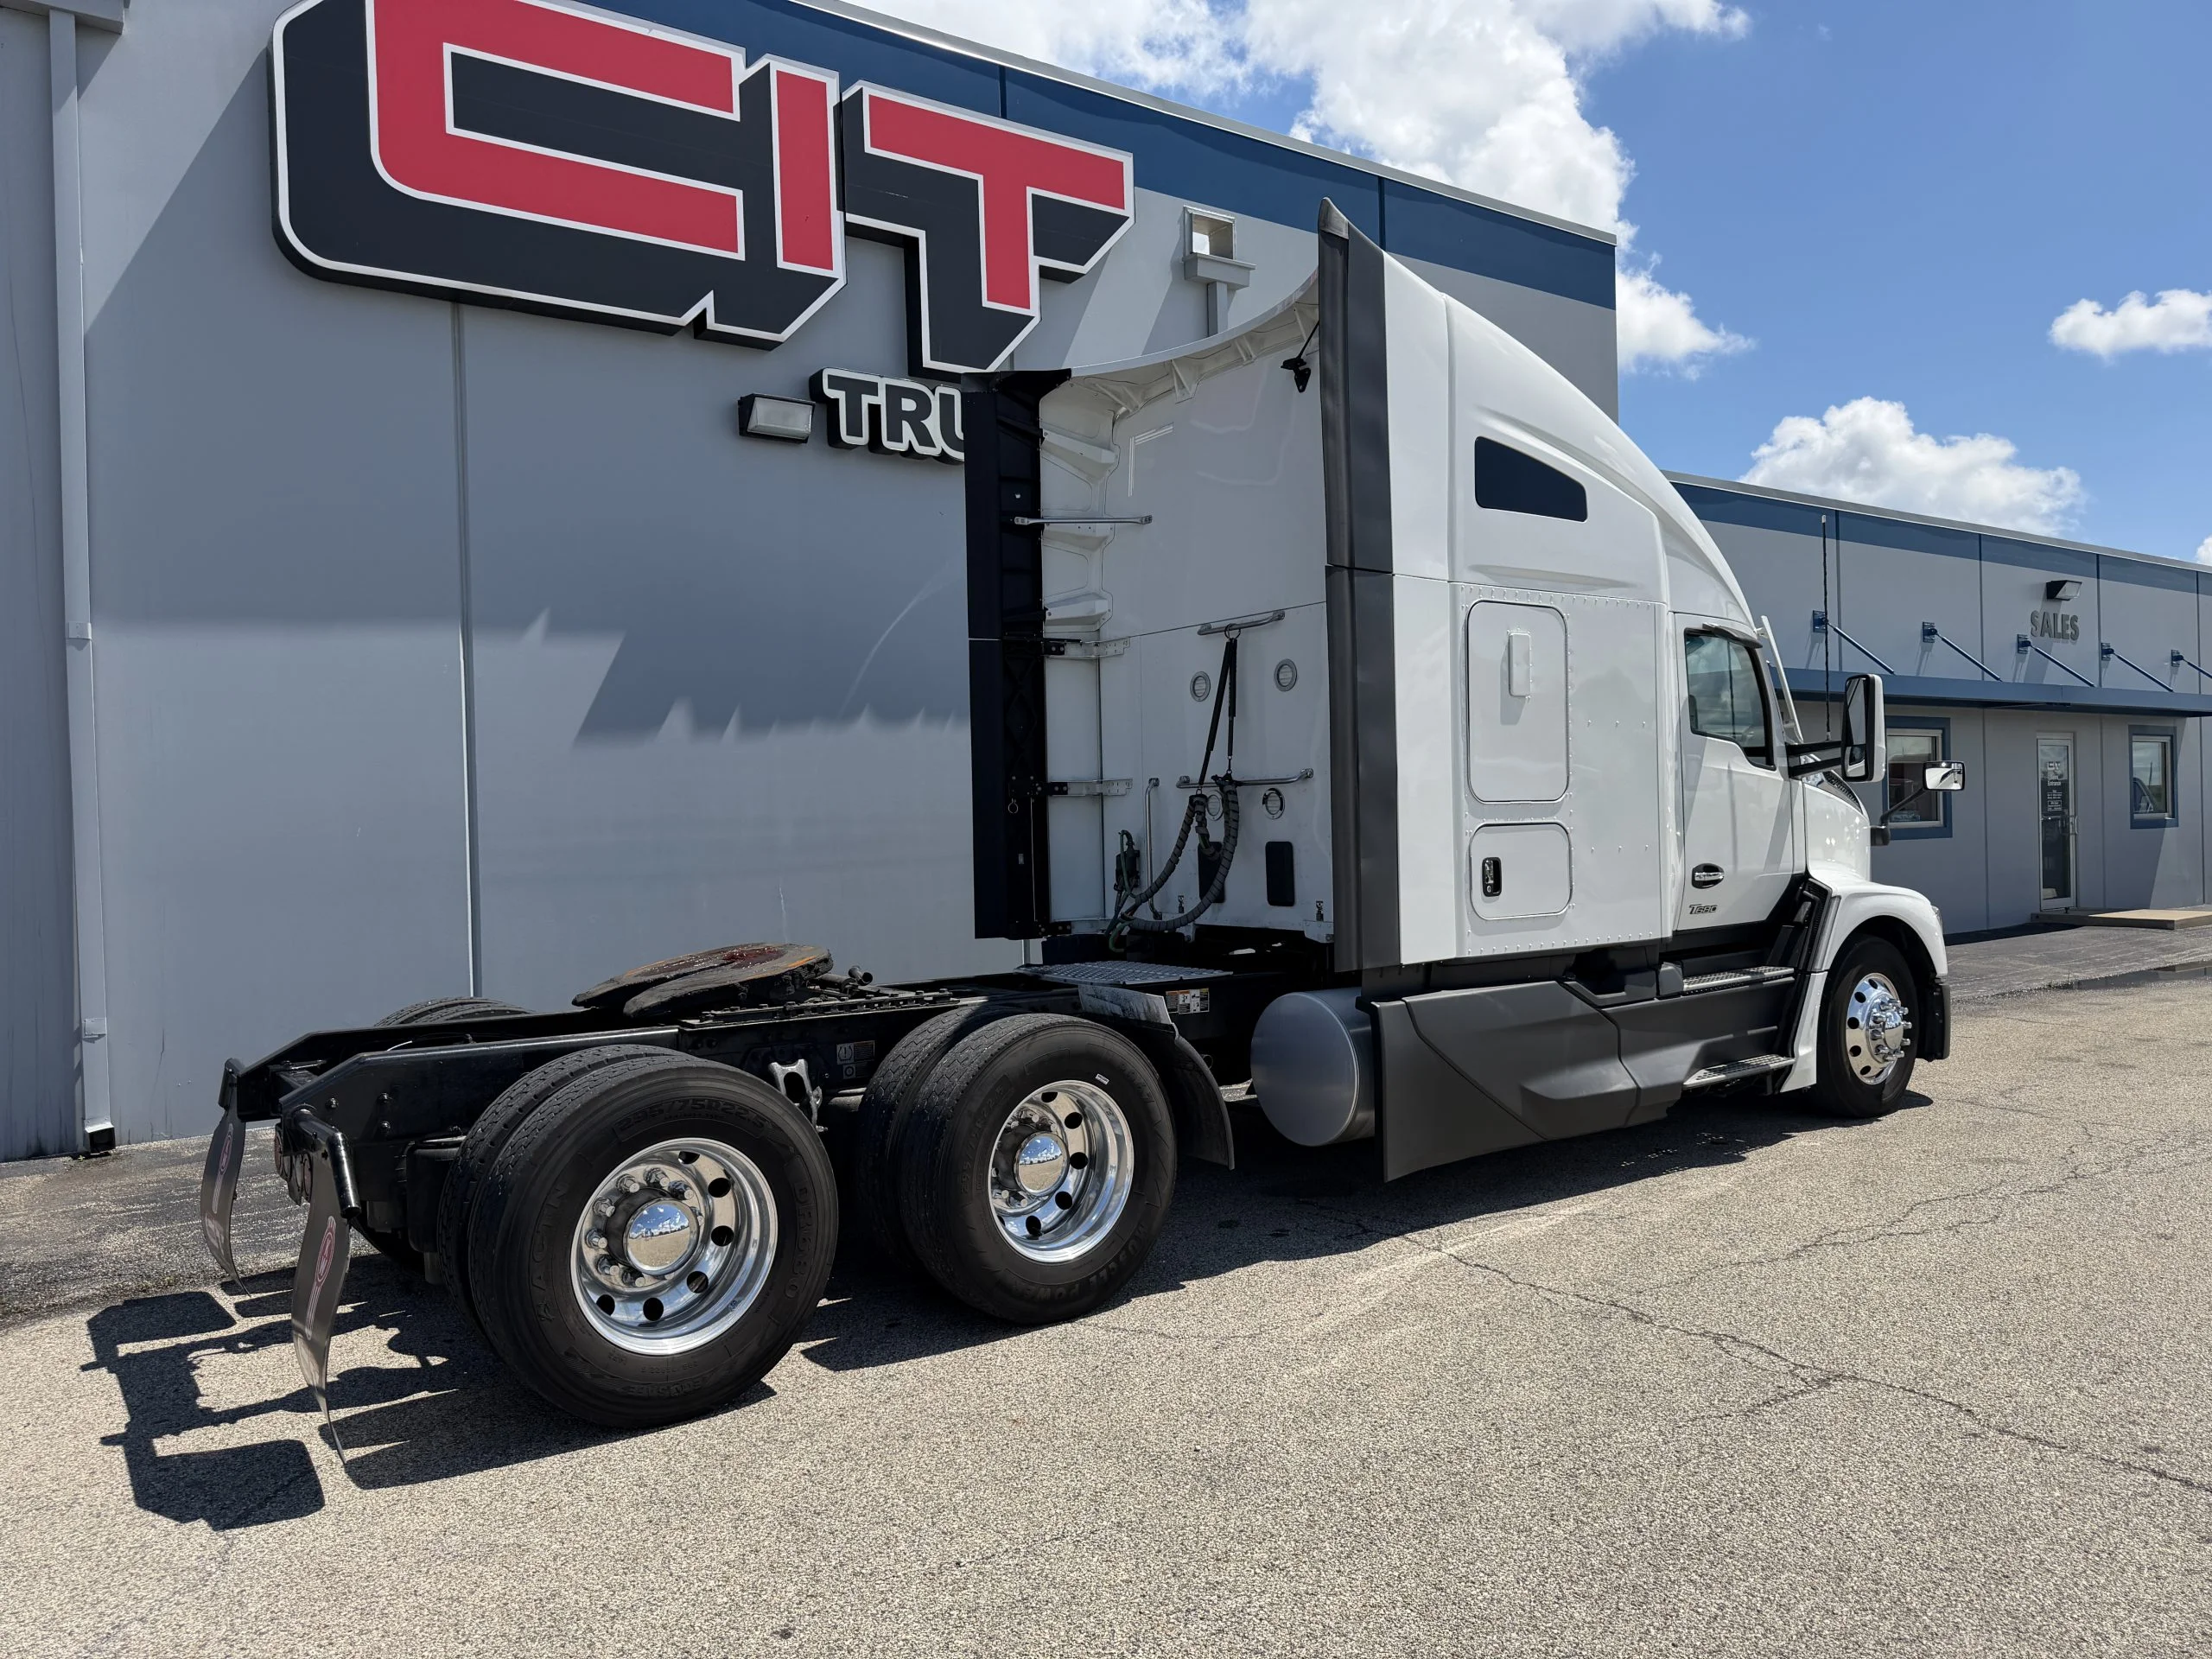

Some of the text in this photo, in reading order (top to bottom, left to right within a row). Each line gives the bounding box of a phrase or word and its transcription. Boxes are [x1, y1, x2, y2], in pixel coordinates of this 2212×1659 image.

[273, 0, 1135, 374] CIT
[2031, 610, 2080, 641] SALES
[1689, 904, 1718, 915] T680
